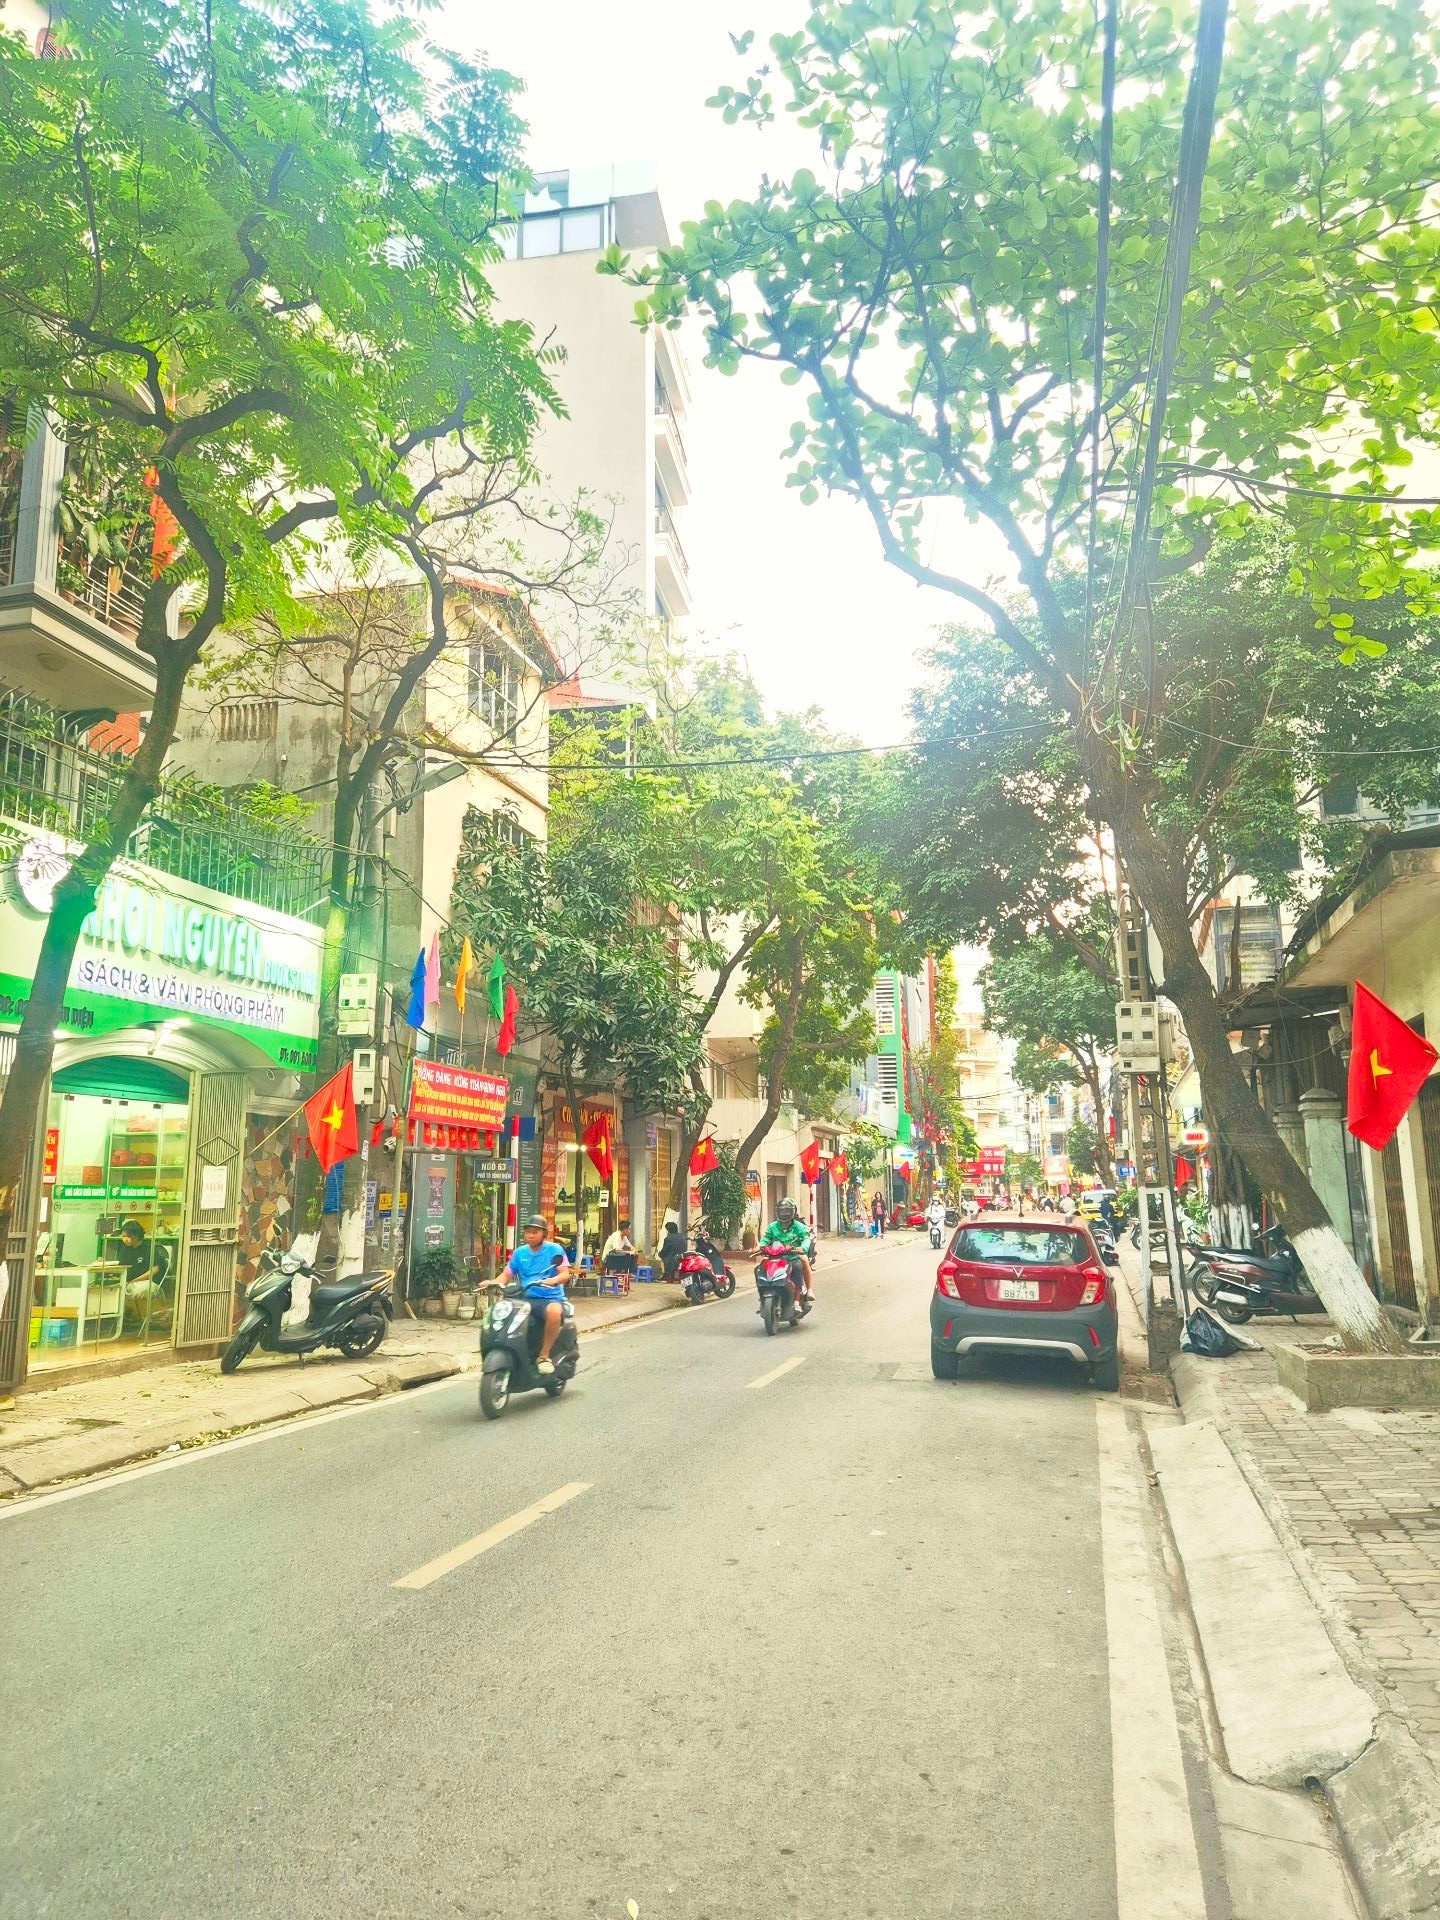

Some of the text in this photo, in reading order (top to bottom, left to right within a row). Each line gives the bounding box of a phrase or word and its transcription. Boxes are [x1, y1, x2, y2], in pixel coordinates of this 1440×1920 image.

[80, 958, 284, 1023] SÁCH & VĂN PHÒNG PHẨM
[481, 1161, 507, 1171] NGÕ 63
